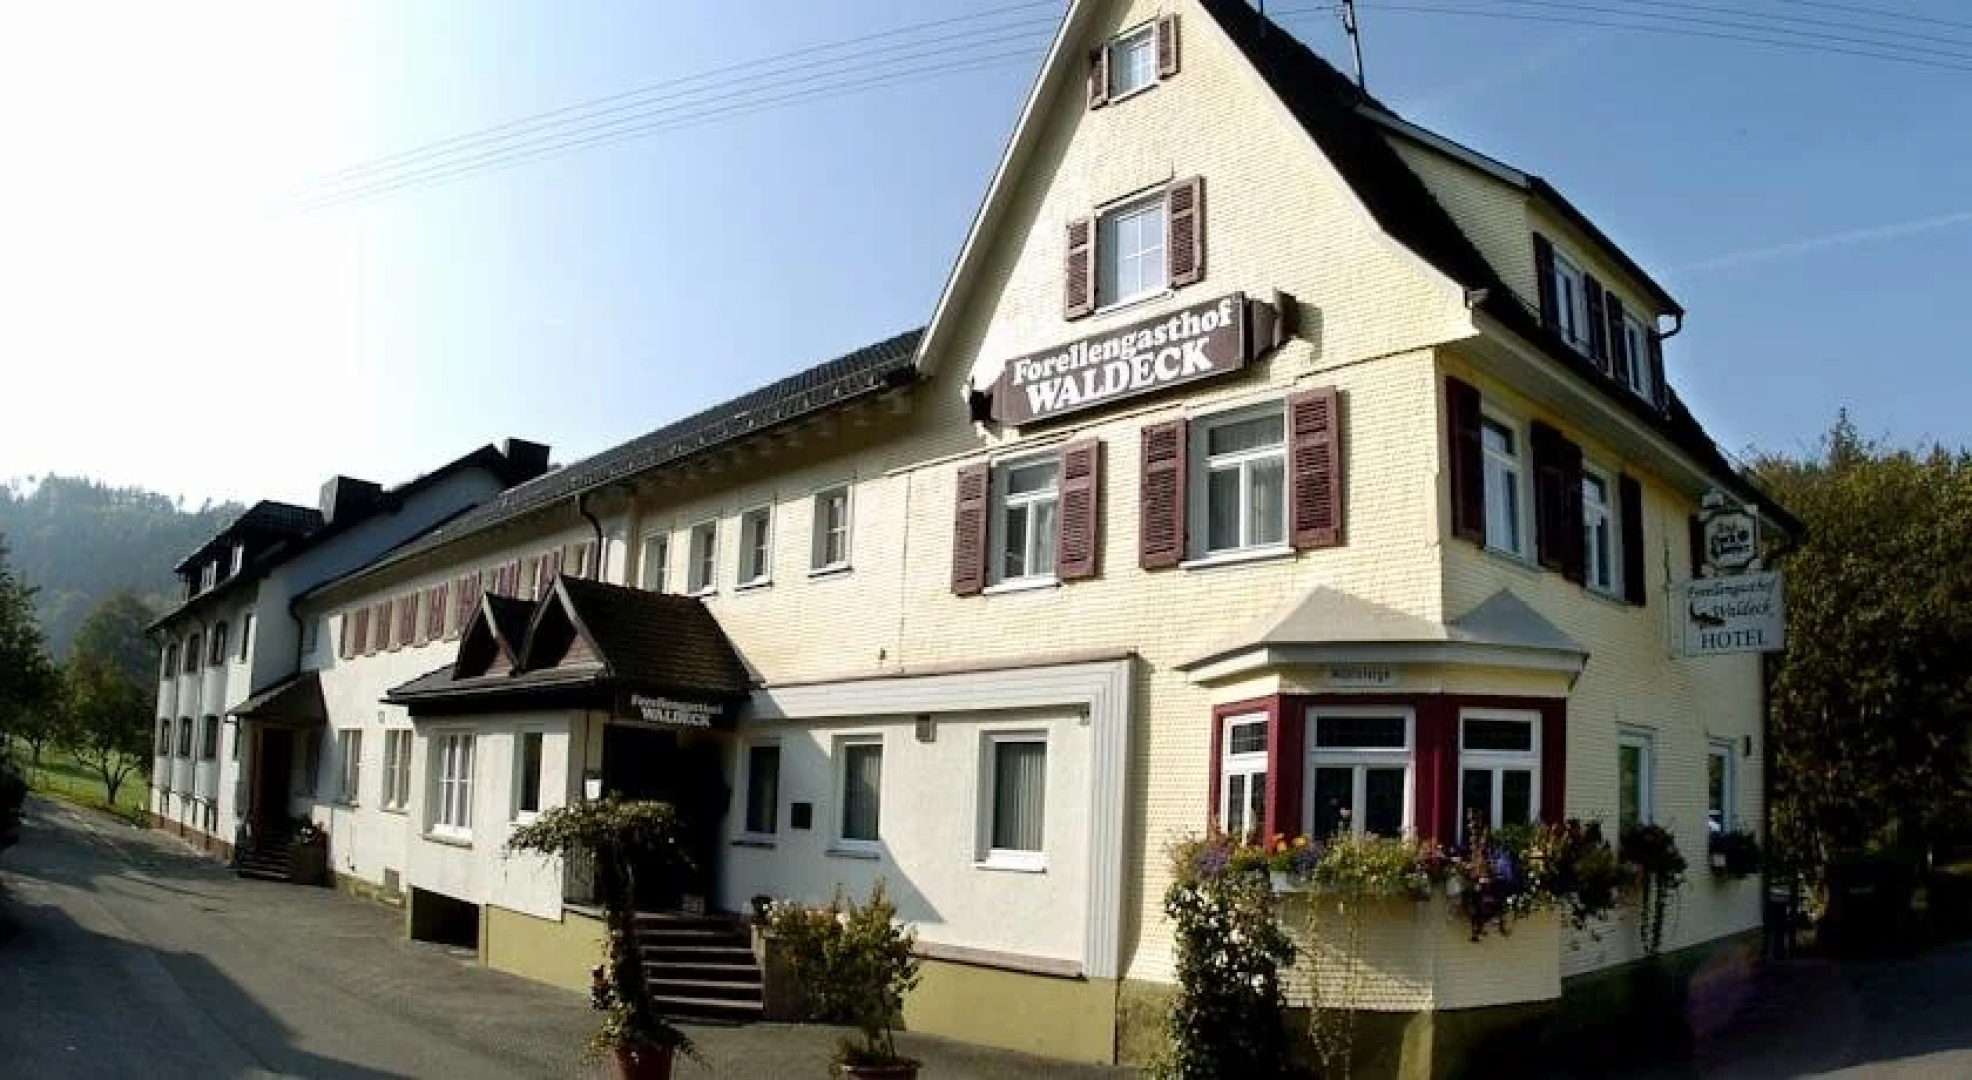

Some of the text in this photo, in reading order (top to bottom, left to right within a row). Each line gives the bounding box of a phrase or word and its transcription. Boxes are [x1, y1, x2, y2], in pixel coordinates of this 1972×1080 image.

[1012, 299, 1233, 386] Forellengasthof
[1024, 336, 1213, 415] WALDECK
[1701, 629, 1769, 649] HOTEL
